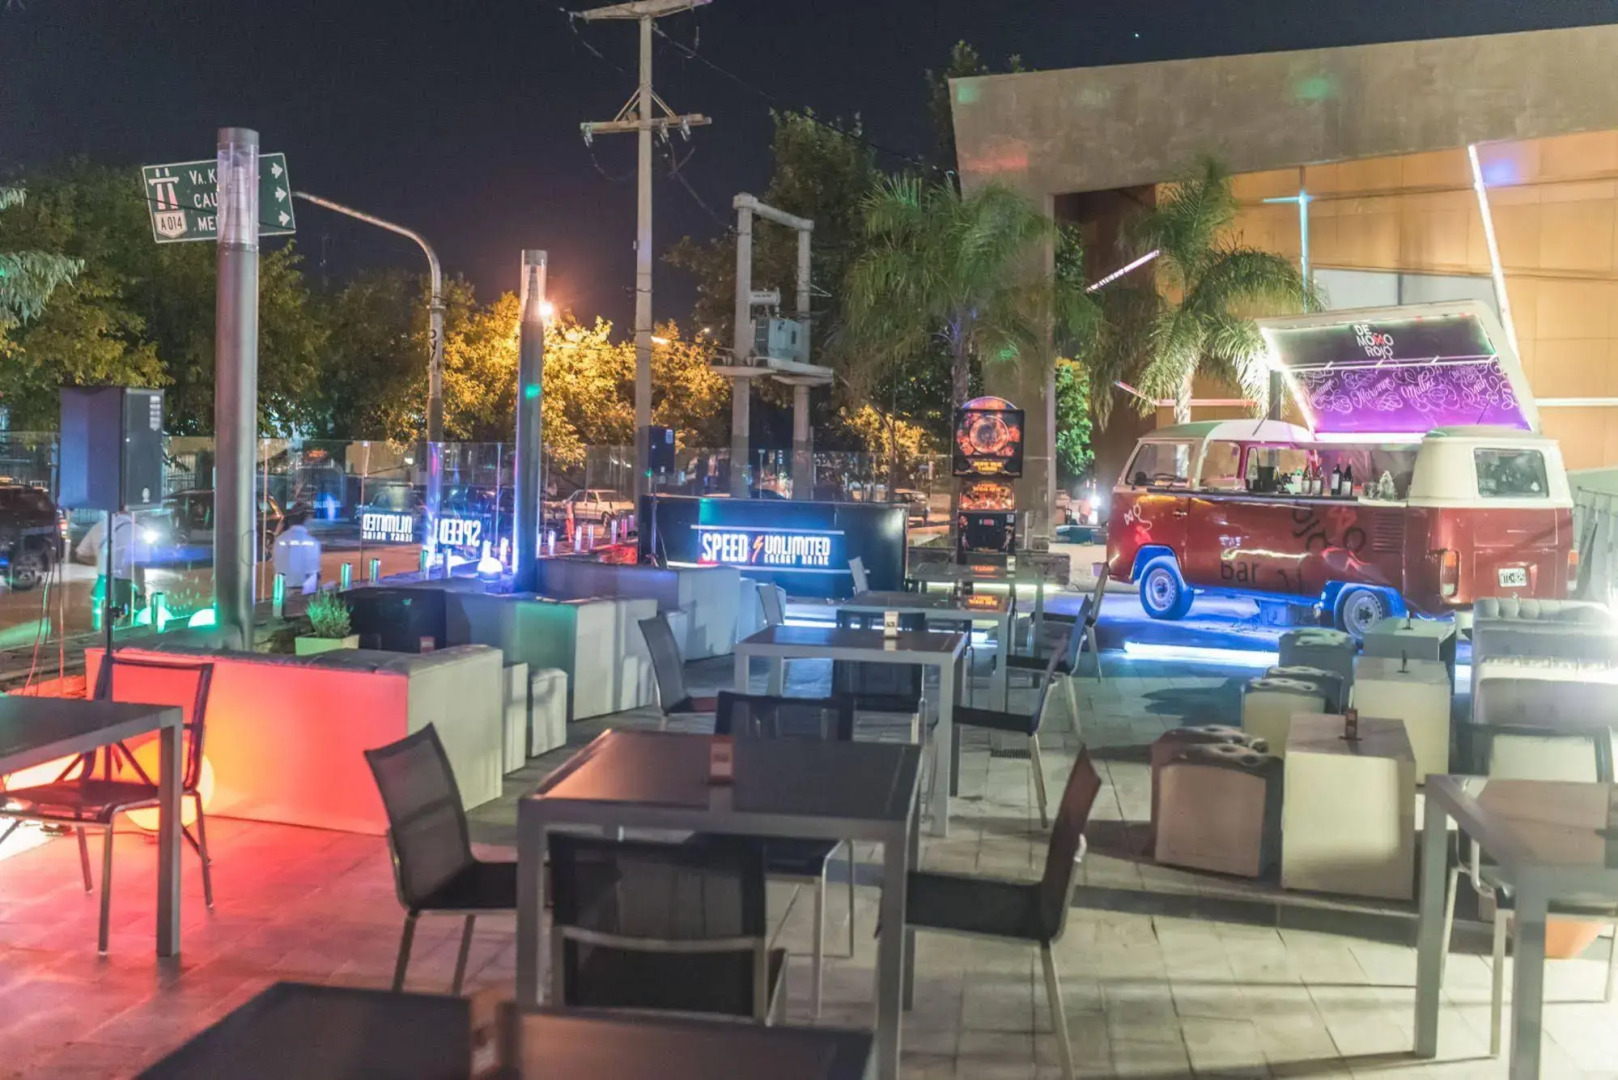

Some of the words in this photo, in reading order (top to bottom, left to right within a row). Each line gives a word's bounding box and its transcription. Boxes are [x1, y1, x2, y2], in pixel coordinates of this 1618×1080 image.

[194, 192, 218, 208] CAU
[197, 216, 218, 231] ME
[1354, 324, 1372, 336] DE
[702, 533, 748, 562] SPEED
[764, 535, 831, 556] UNLIMITED
